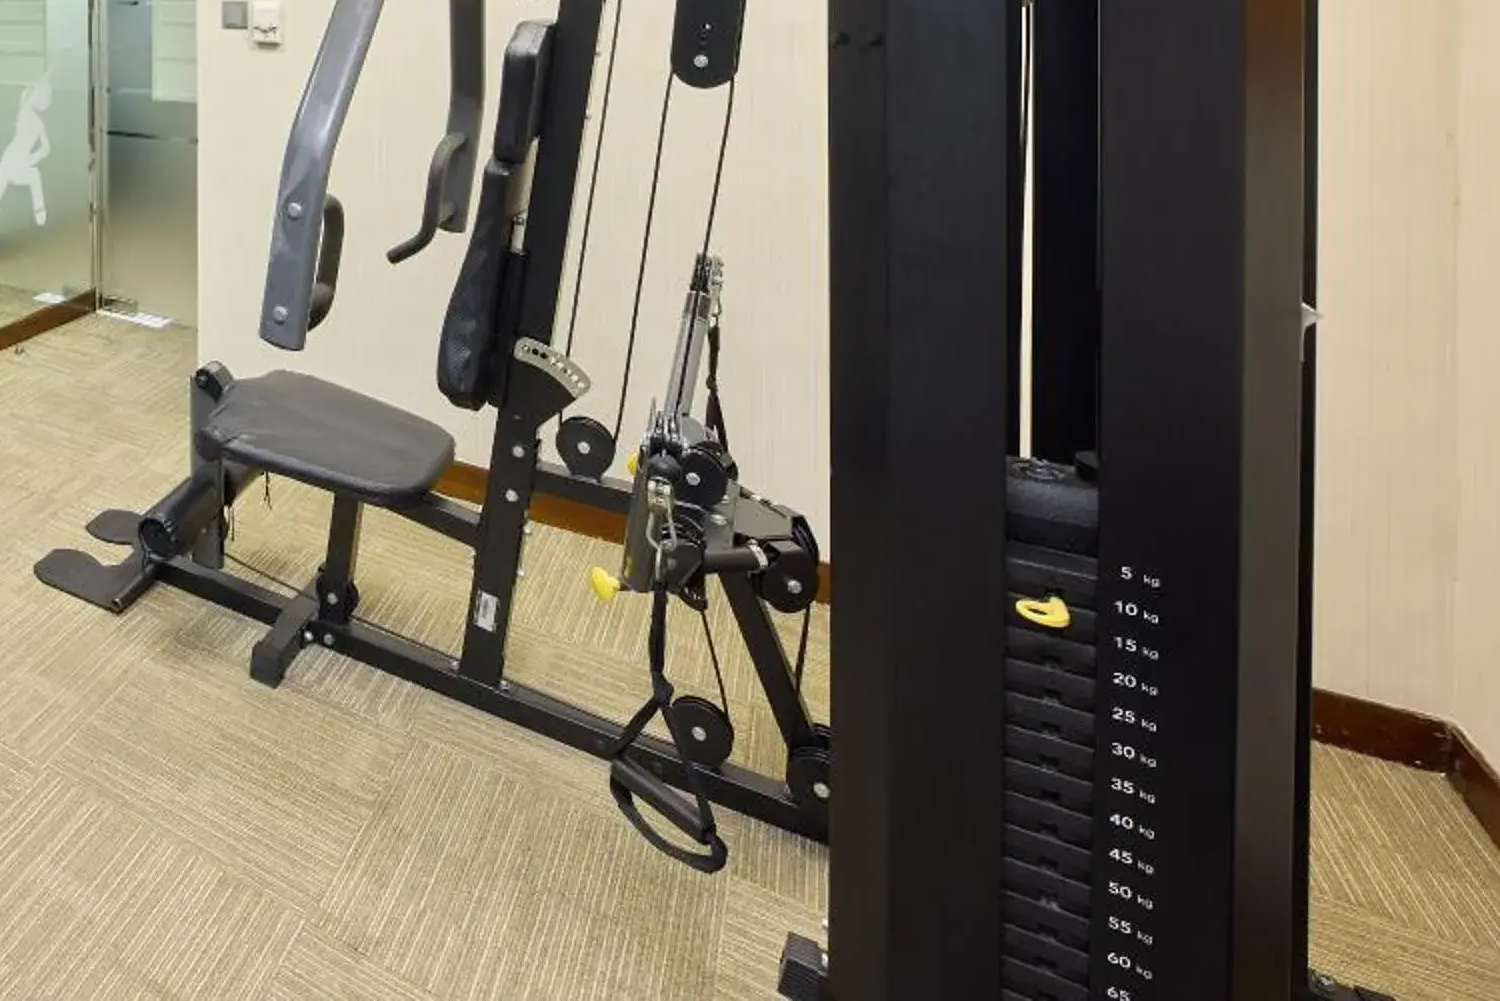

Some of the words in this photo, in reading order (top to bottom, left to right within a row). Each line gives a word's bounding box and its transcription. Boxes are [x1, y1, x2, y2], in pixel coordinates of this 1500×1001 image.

[1120, 566, 1133, 580] 5
[1143, 574, 1161, 588] kg
[1114, 600, 1139, 616] 10
[1143, 610, 1159, 625] kg
[1114, 636, 1137, 652] 15
[1142, 646, 1159, 660] kg
[1112, 671, 1137, 688] 20
[1141, 682, 1158, 696] kg
[1111, 706, 1136, 724] 25
[1141, 718, 1157, 732] kg
[1111, 742, 1136, 760] 30
[1139, 754, 1157, 768] kg
[1110, 777, 1135, 795] 35
[1139, 789, 1156, 804] kg
[1109, 813, 1134, 830] 40
[1138, 824, 1155, 840] kg
[1108, 848, 1133, 865] 45
[1137, 860, 1155, 875] kg
[1107, 880, 1133, 900] 50
[1136, 894, 1154, 910] kg
[1107, 915, 1132, 934] 55
[1136, 930, 1154, 946] kg
[1107, 952, 1131, 969] 60
